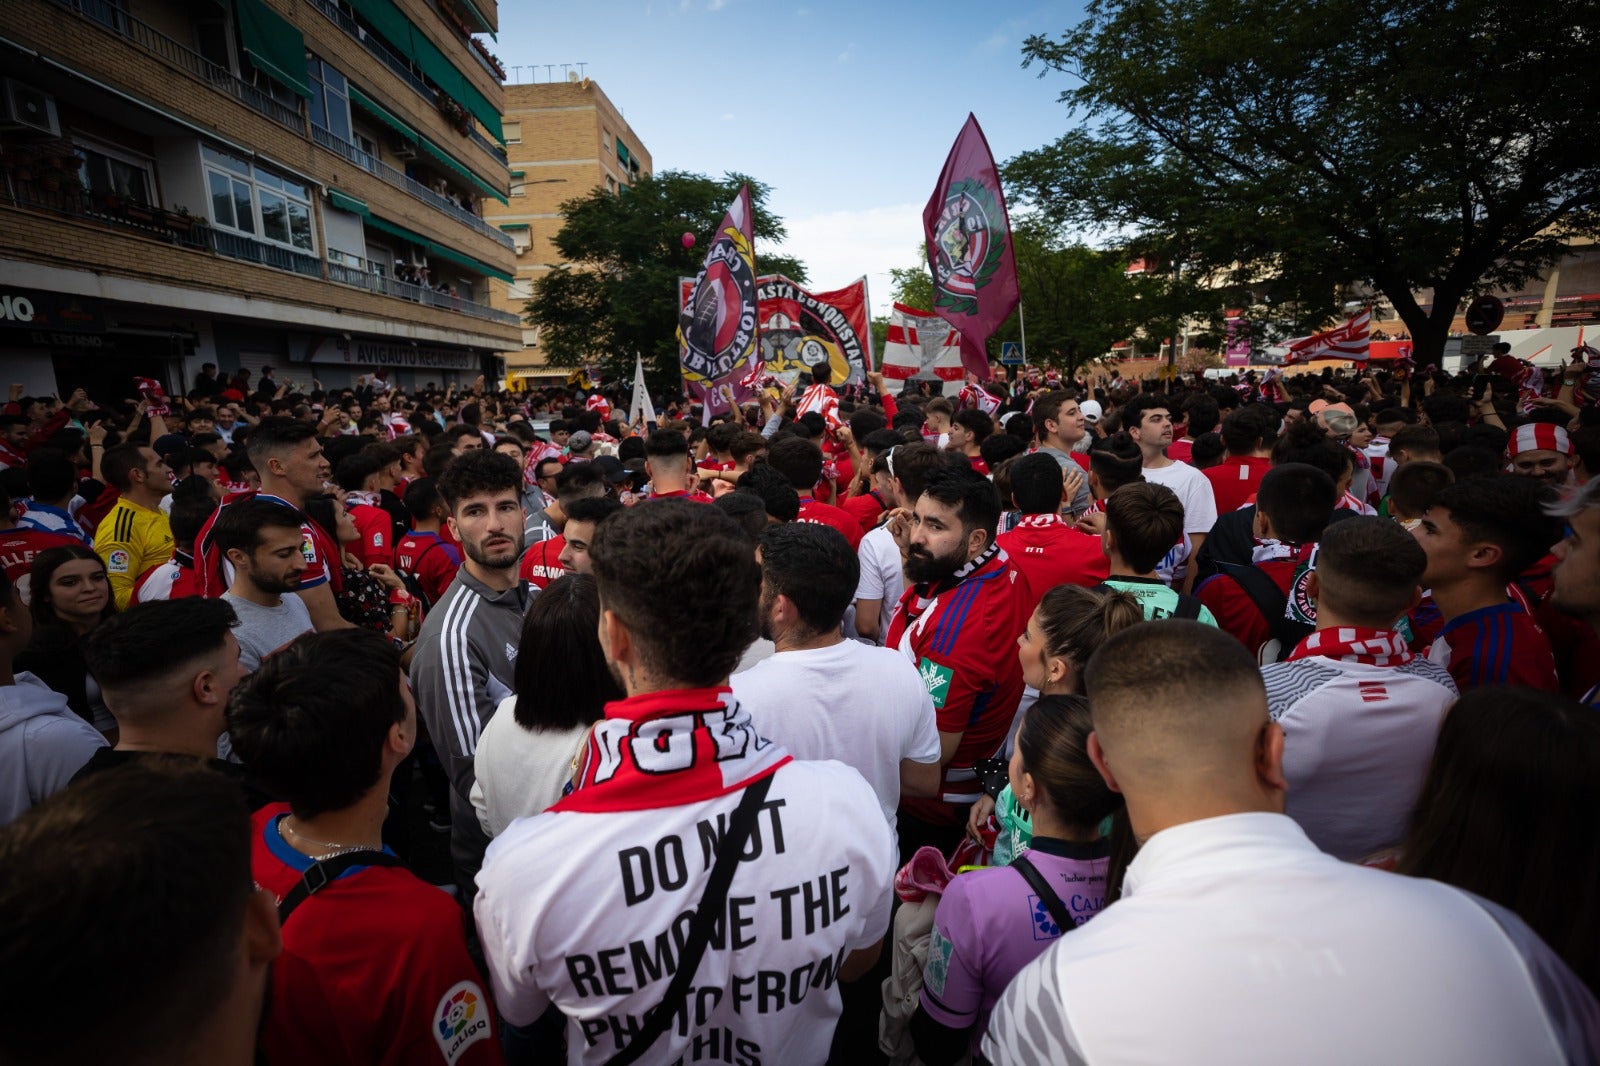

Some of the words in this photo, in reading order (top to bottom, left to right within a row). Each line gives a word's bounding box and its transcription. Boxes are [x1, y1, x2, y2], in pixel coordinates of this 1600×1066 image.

[0, 296, 35, 322] IO
[357, 343, 416, 366] AVIGAUTO
[418, 350, 469, 368] RECAMBIOS
[618, 826, 689, 908] DO
[770, 865, 851, 940] THE
[579, 985, 723, 1049] PHTO
[732, 945, 847, 1015] FROM
[447, 1019, 486, 1059] LaLiga
